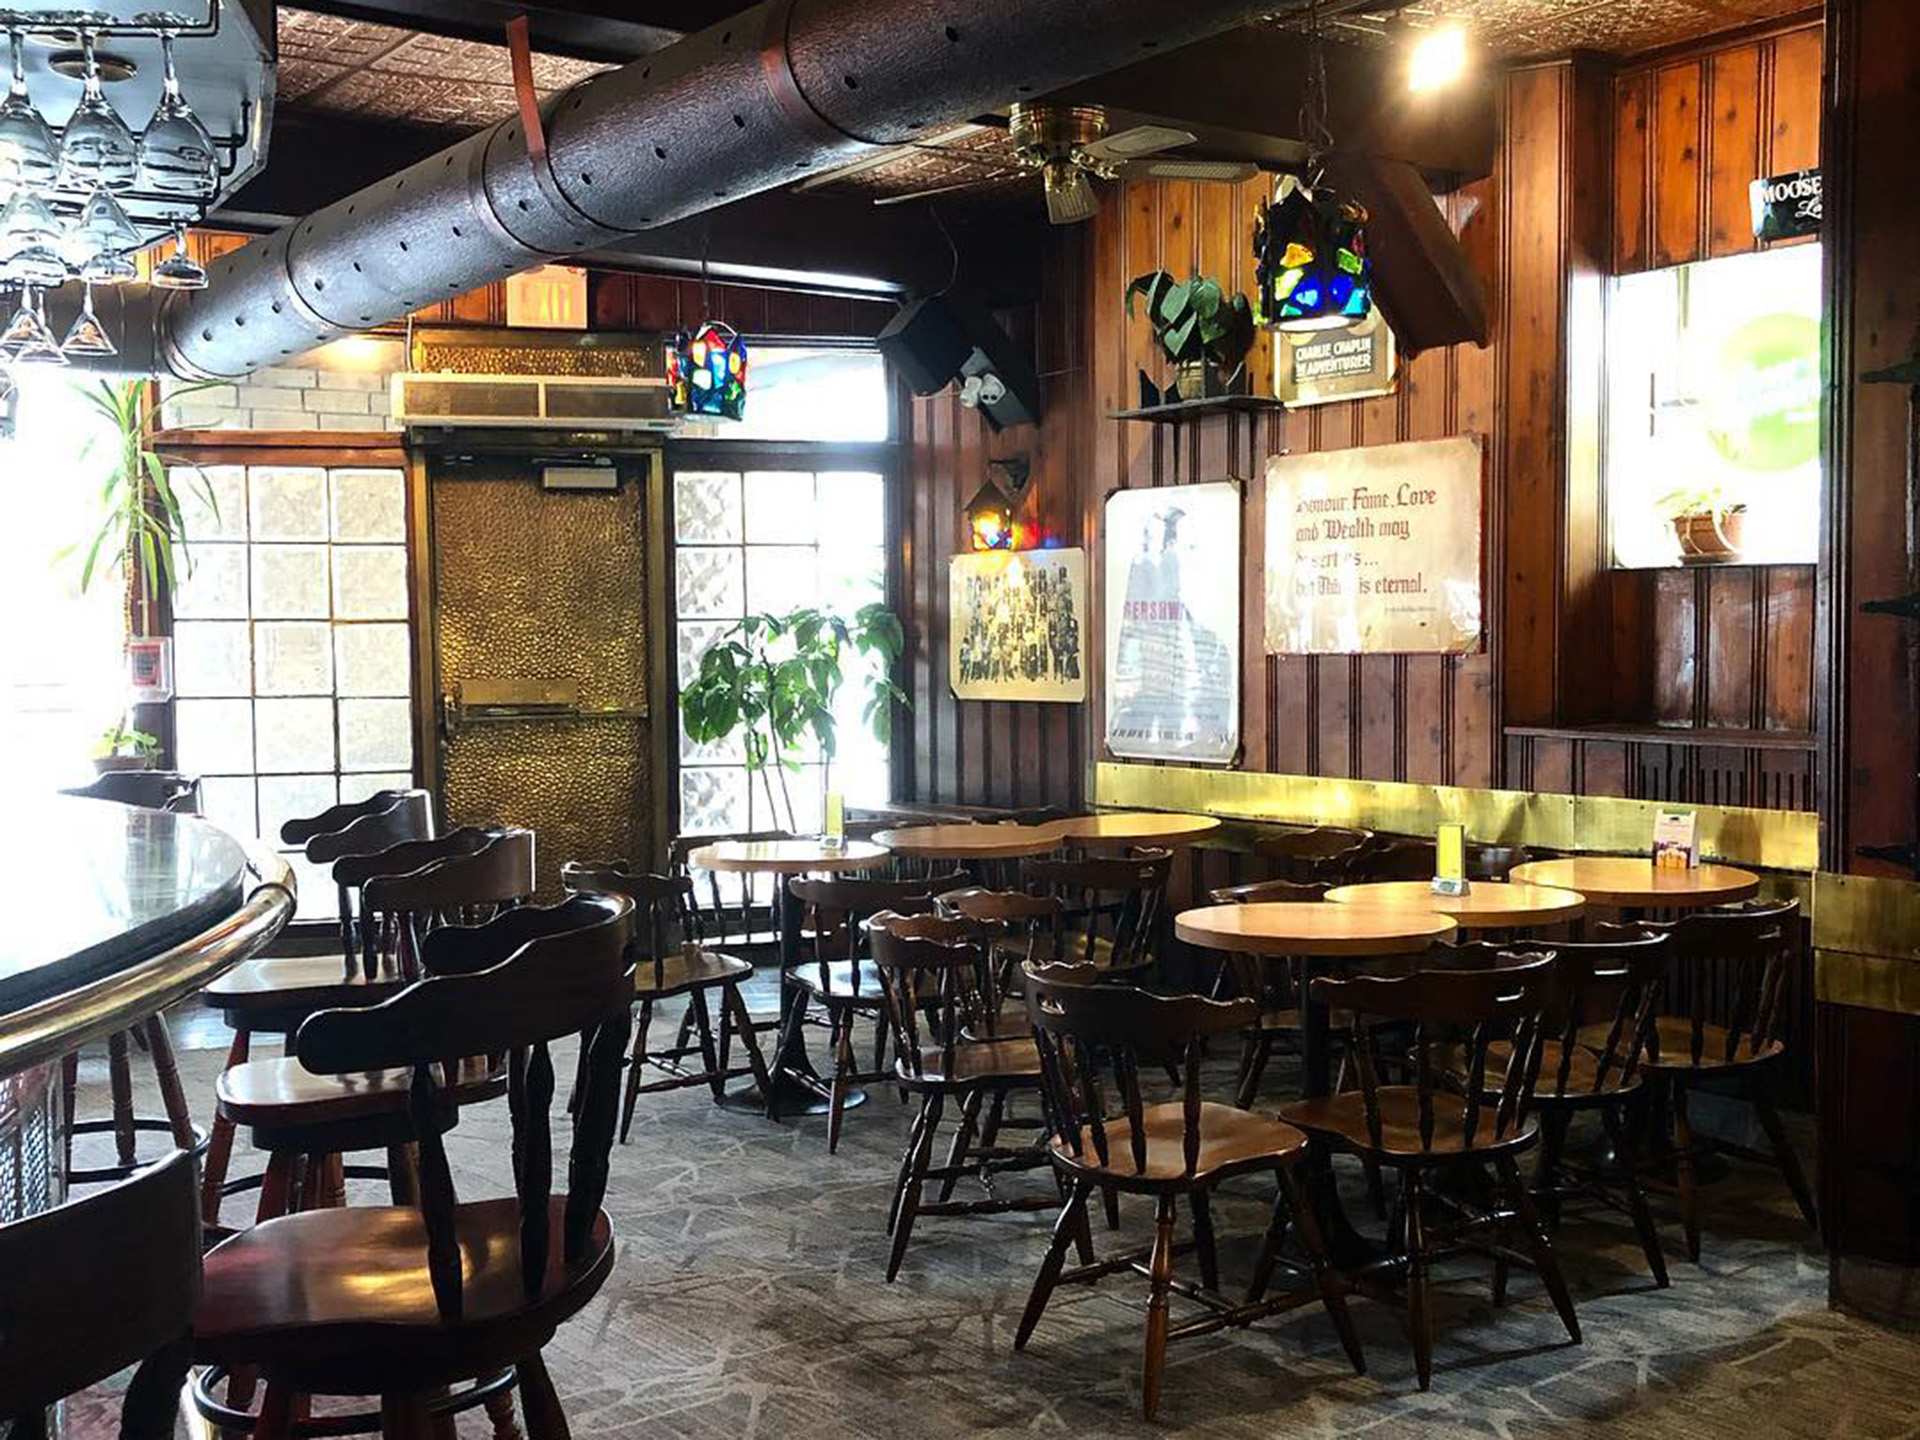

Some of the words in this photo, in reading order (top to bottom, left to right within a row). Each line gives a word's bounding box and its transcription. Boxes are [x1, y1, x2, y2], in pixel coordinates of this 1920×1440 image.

[1333, 337, 1371, 357] CHAPLIN
[1397, 482, 1438, 507] Love
[1296, 521, 1319, 543] and
[1323, 516, 1374, 541] Wealth
[1379, 519, 1411, 542] may
[1359, 576, 1372, 594] is
[1375, 571, 1428, 594] eternal.
